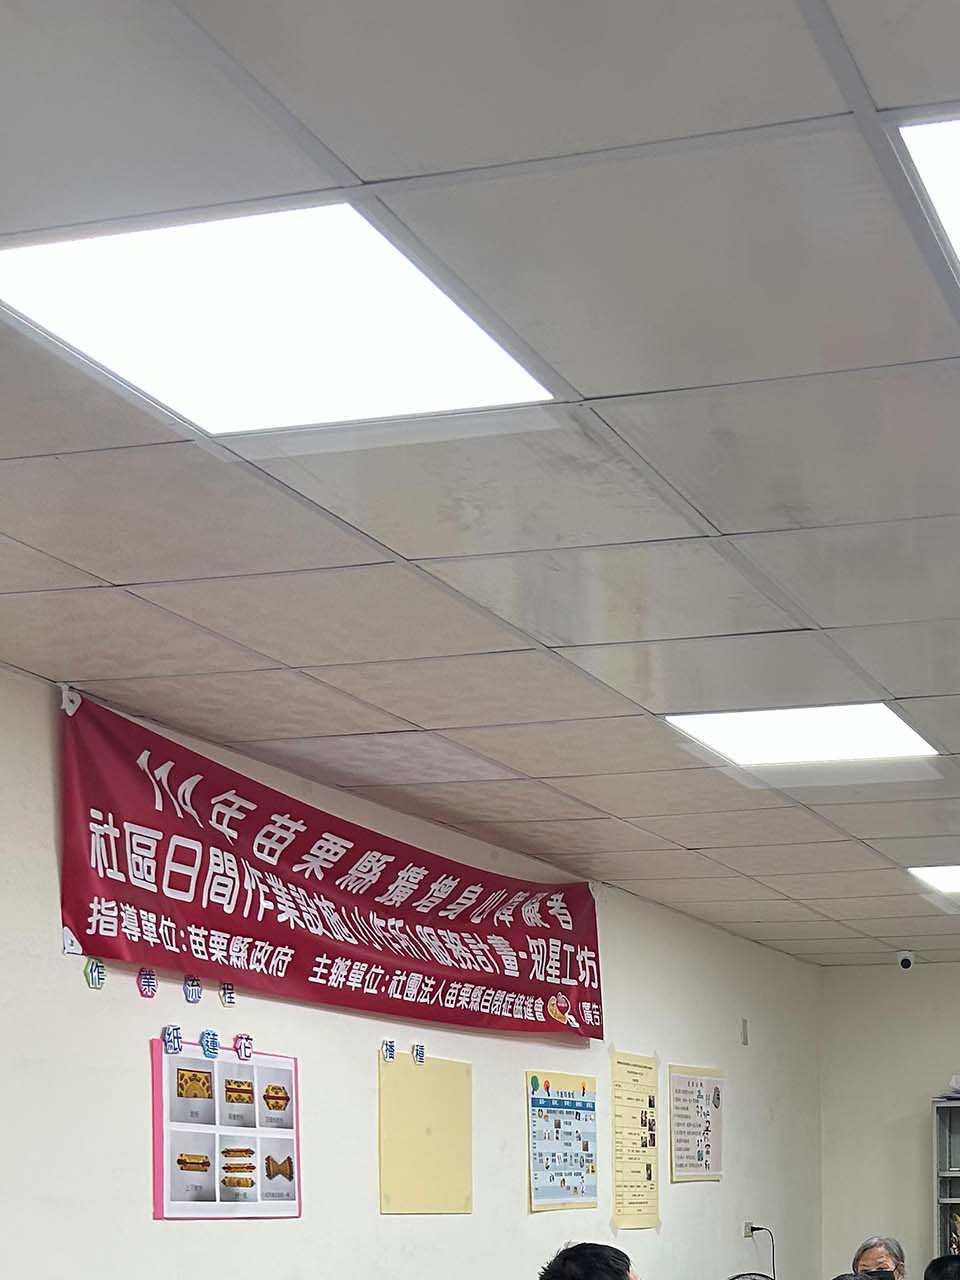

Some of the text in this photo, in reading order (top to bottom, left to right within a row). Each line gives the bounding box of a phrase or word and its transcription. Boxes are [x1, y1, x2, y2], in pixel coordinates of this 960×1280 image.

[86, 896, 295, 977] 指導單位:苗栗縣政府
